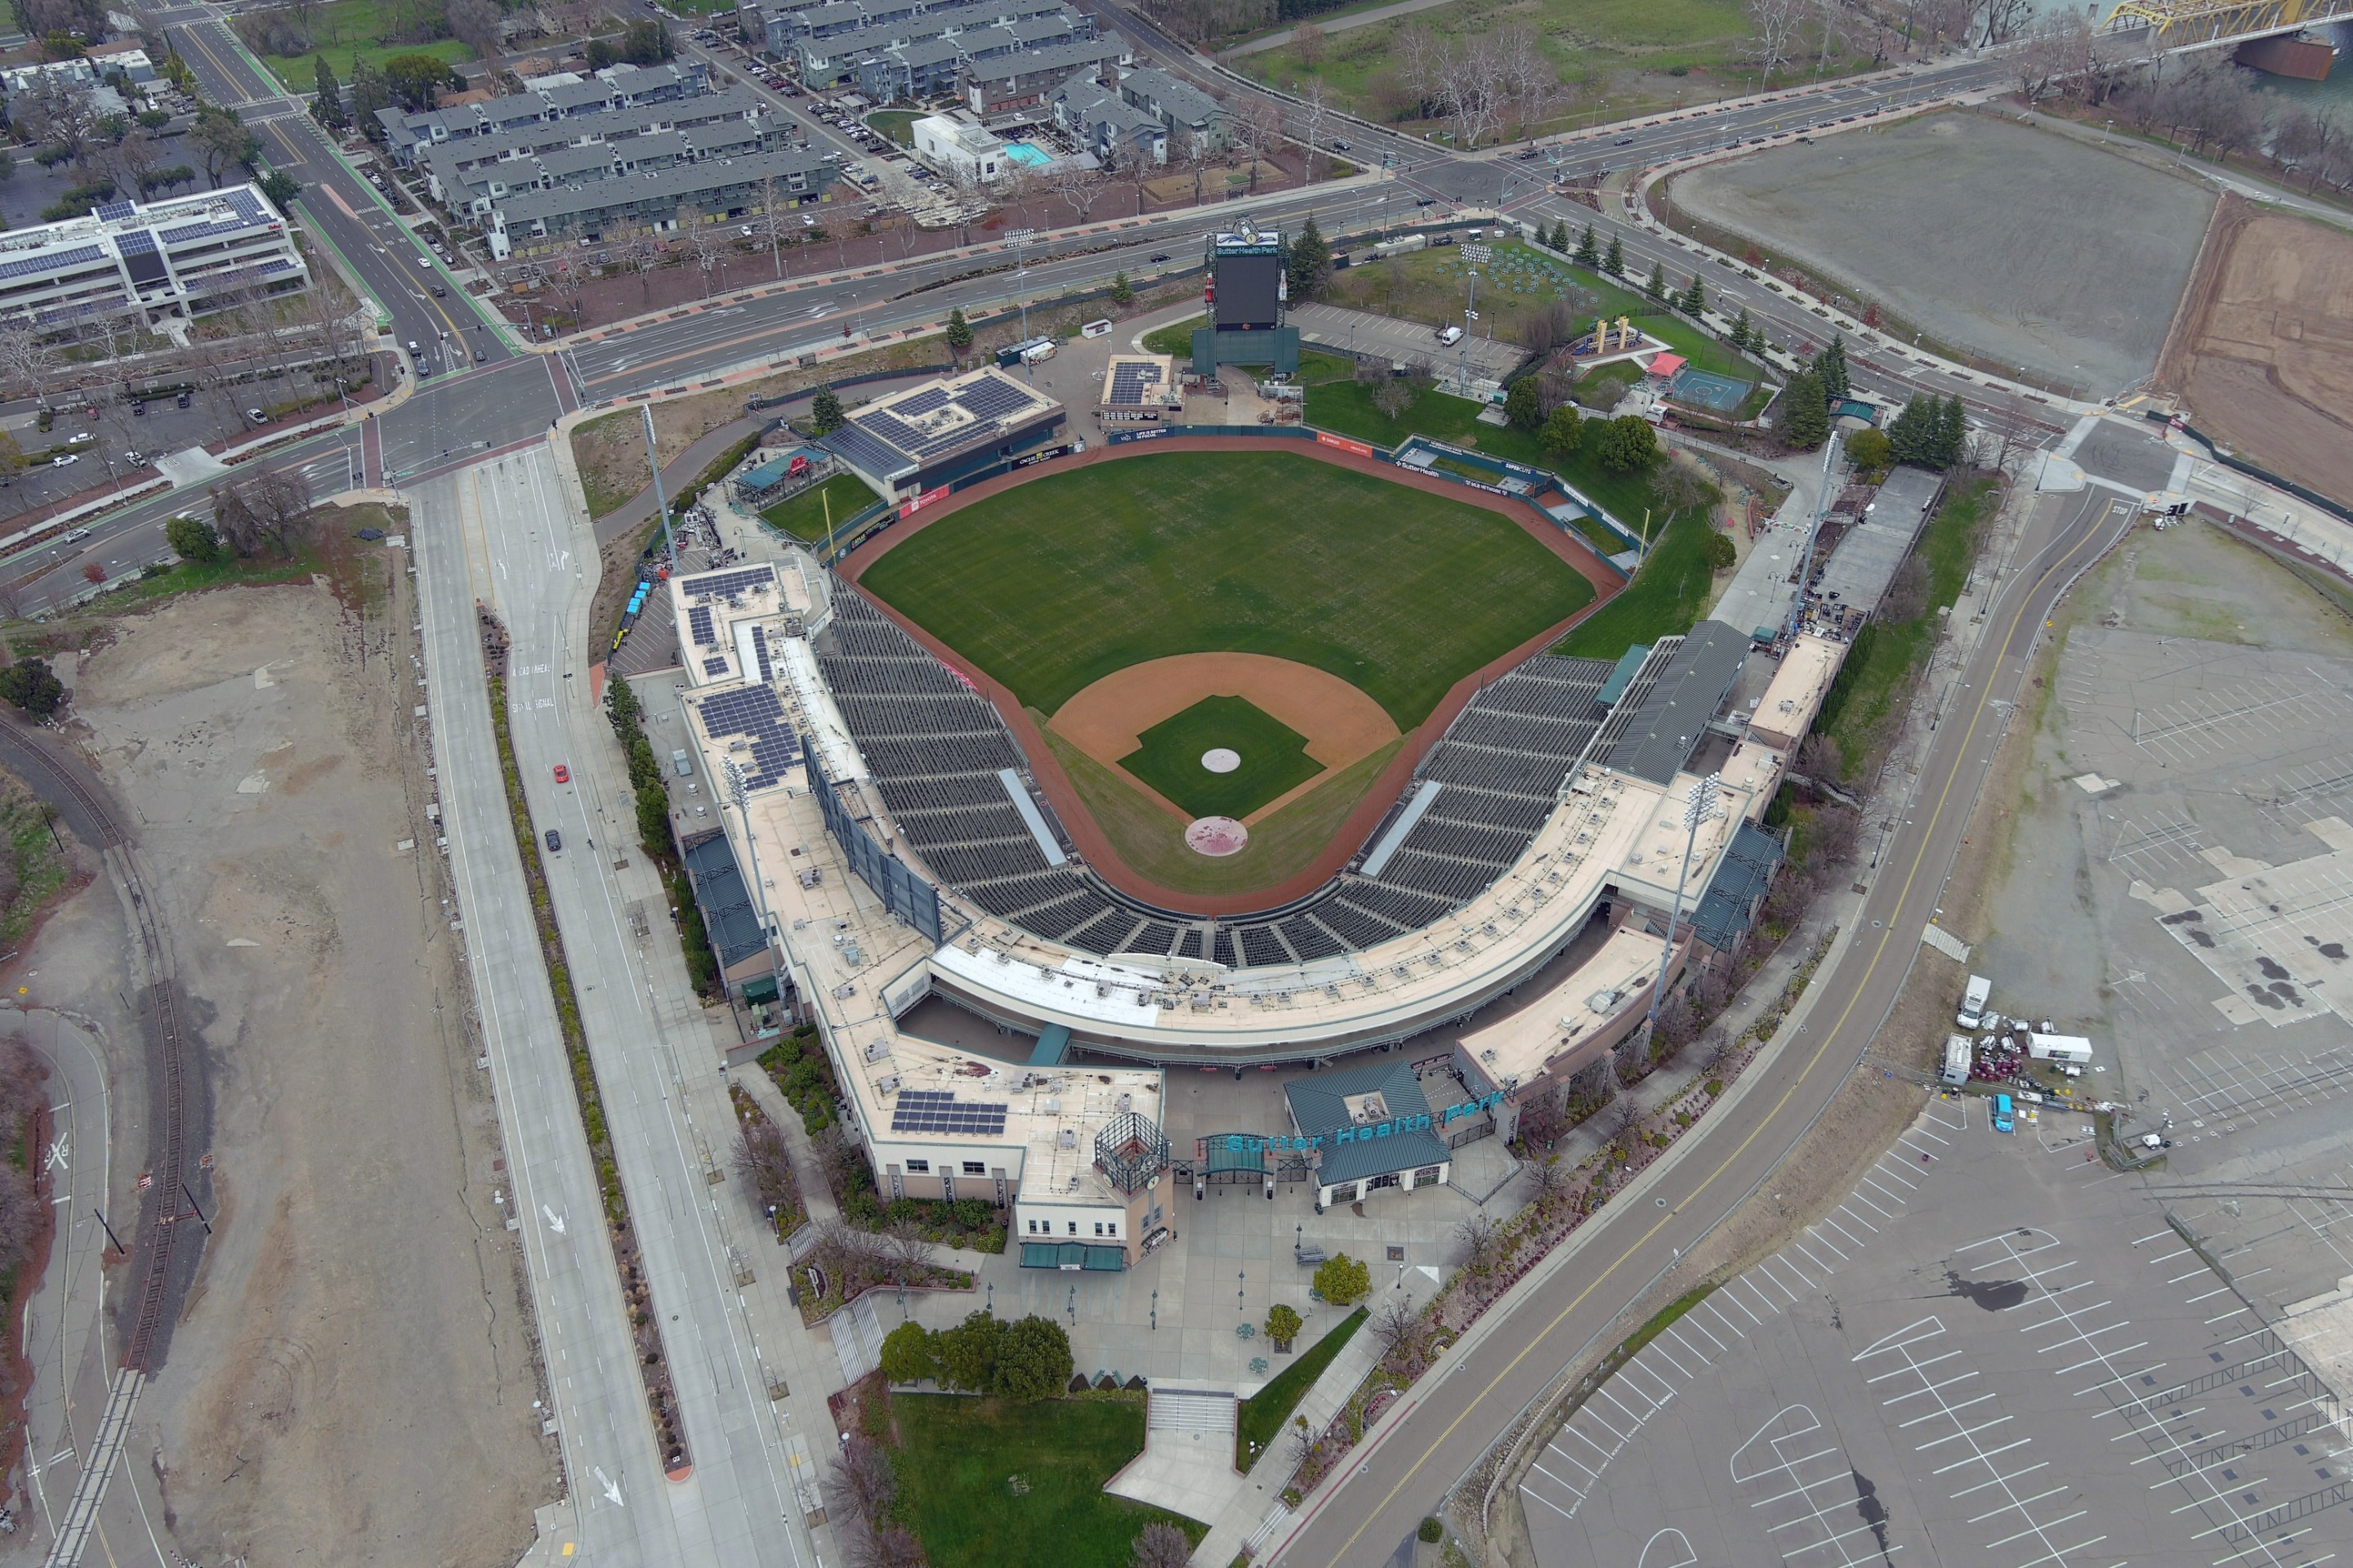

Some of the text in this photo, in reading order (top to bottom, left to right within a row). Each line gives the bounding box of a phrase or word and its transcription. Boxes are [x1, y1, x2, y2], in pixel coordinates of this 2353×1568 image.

[1326, 437, 1340, 445] SMUD
[1043, 449, 1060, 458] CREEK
[1402, 462, 1440, 477] Sutter Health
[1505, 463, 1531, 475] SUPERCUTS
[1480, 484, 1502, 495] NETWORK
[919, 494, 936, 505] TOYOTA
[2112, 506, 2128, 515] STOP
[1226, 1091, 1505, 1153] Sutter Health Park
